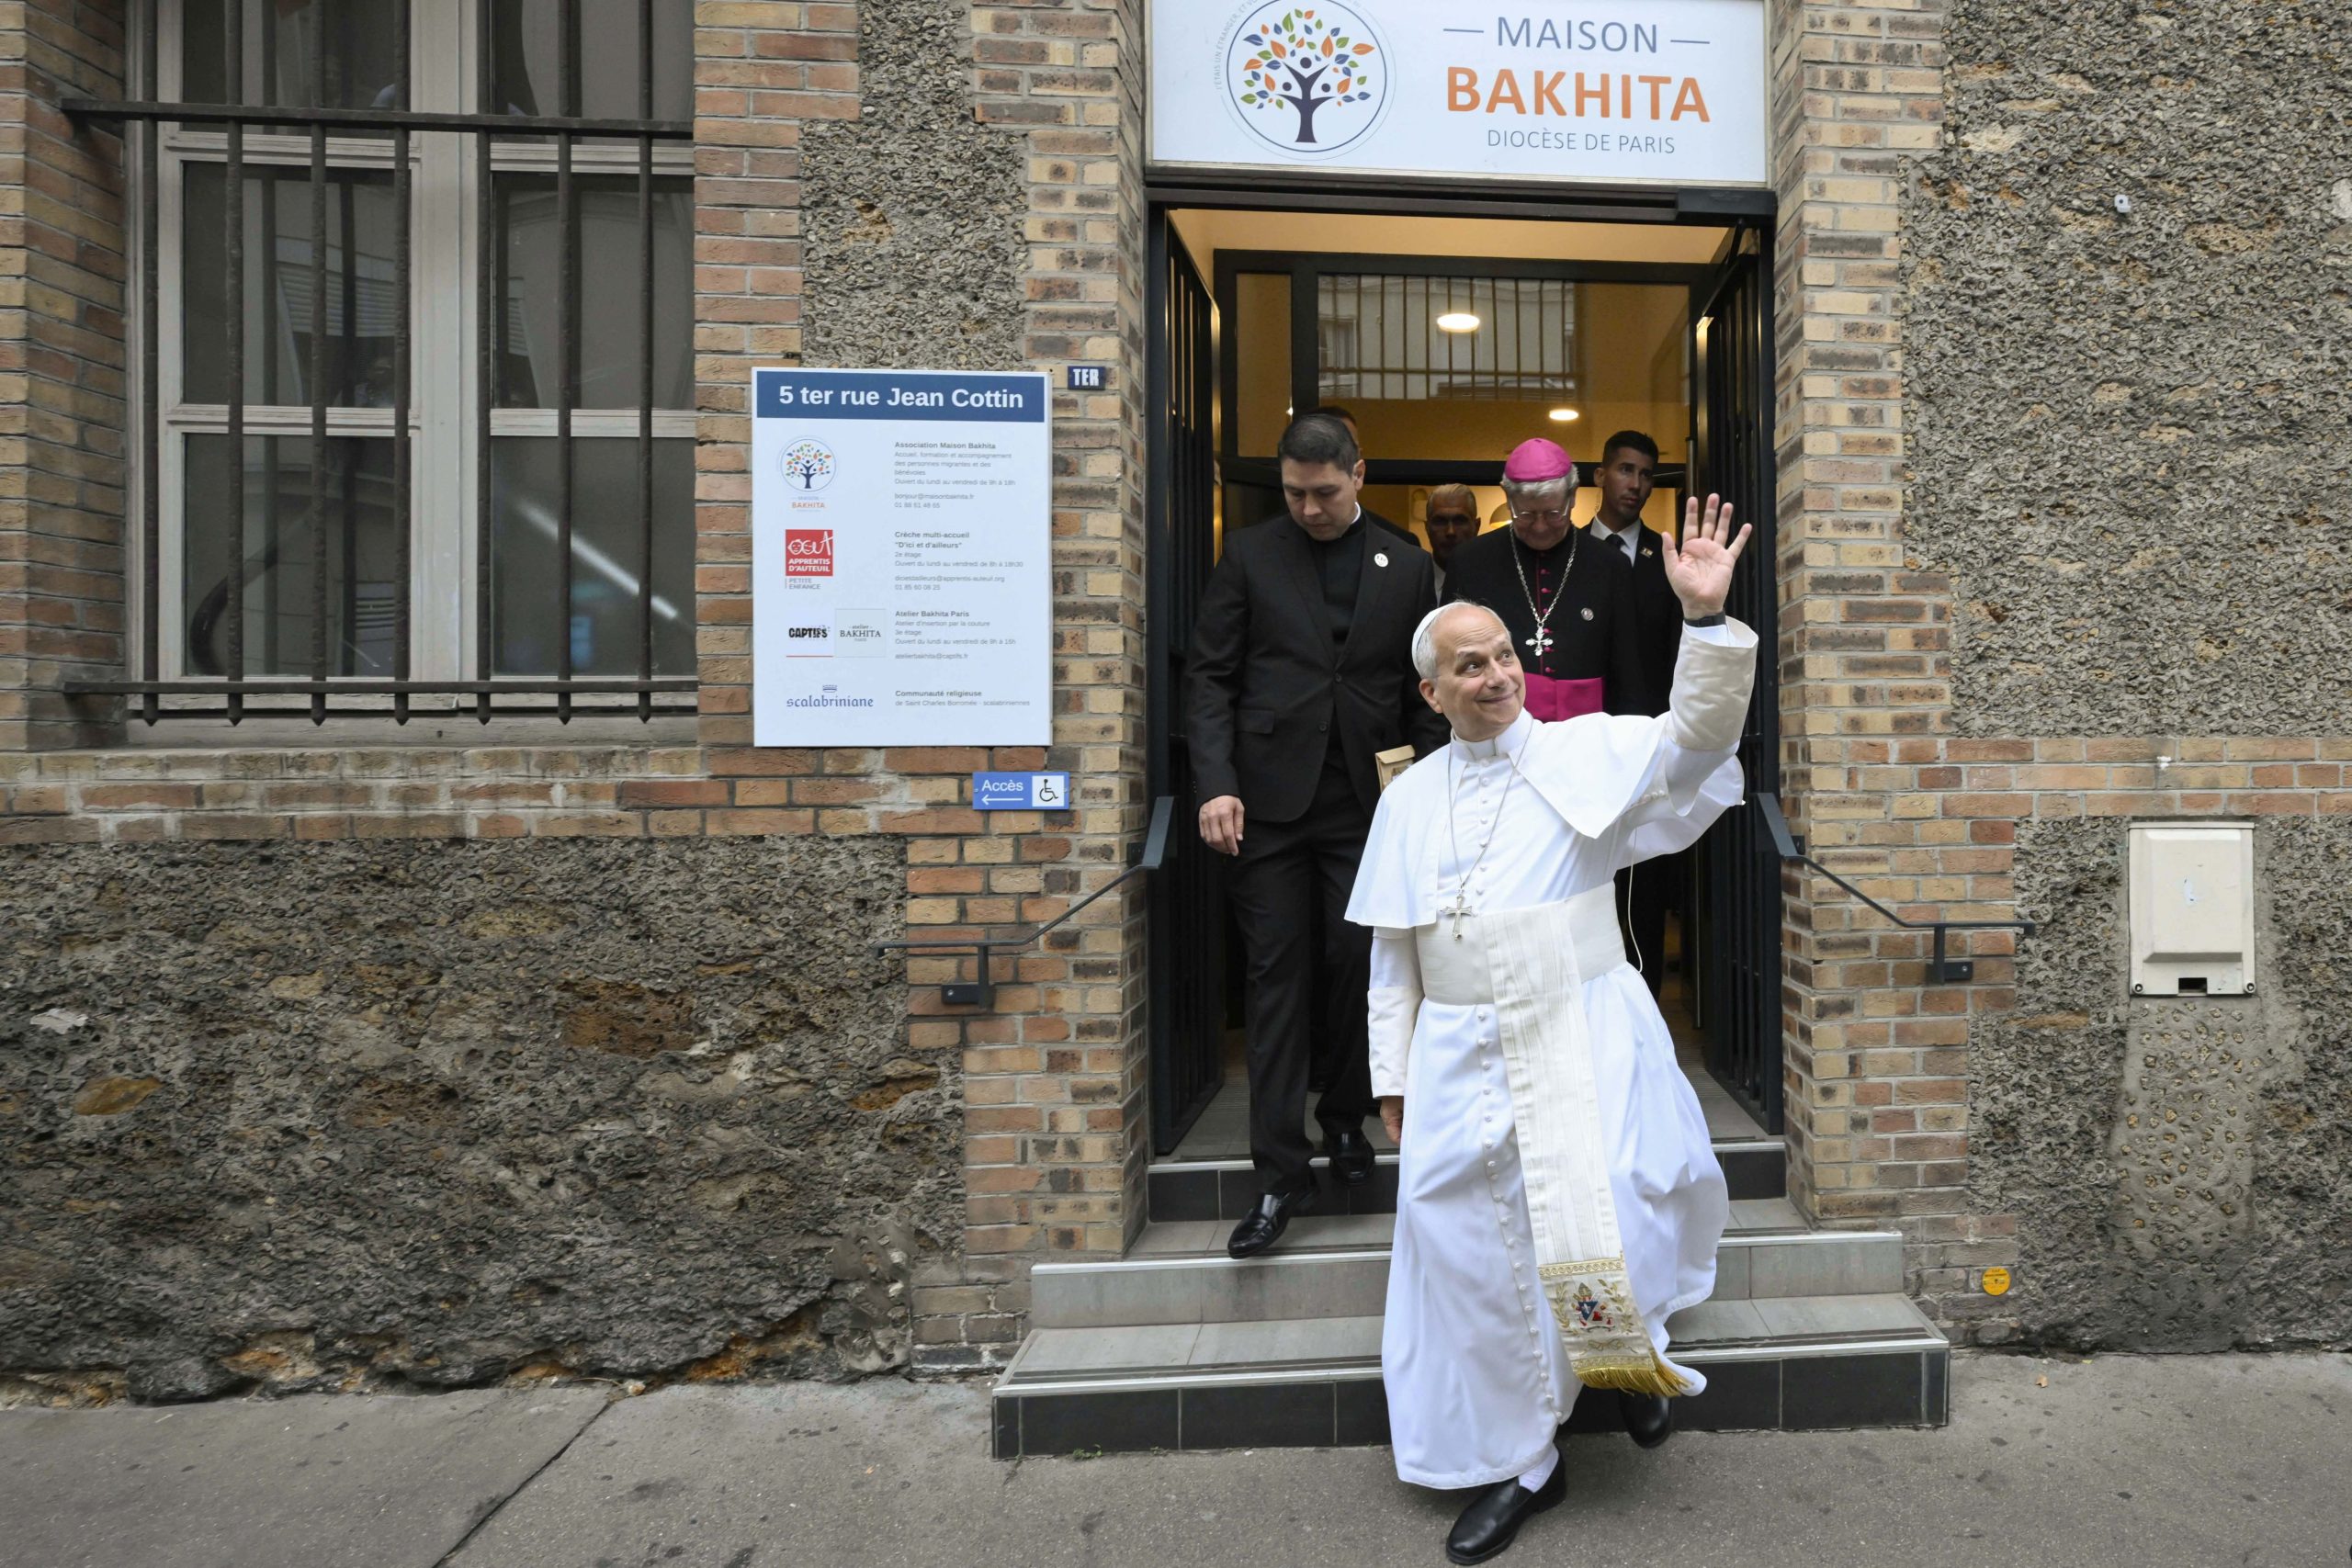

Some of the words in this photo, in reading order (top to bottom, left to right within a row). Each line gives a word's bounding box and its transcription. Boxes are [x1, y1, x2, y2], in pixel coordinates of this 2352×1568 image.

[1498, 17, 1657, 53] MAISON
[1447, 67, 1711, 122] BAKHITA
[1487, 128, 1577, 150] DIOCÈSE
[1585, 134, 1611, 151] DE
[1619, 136, 1675, 154] PARIS
[1073, 368, 1100, 386] TER
[779, 385, 794, 404] 5
[800, 387, 833, 405] ter
[841, 390, 880, 406] rue
[886, 387, 944, 407] Jean
[951, 389, 1023, 409] Cottin
[788, 627, 828, 638] CAPTIFS
[786, 695, 874, 707] scalabriniane
[981, 780, 1024, 792] Accès
